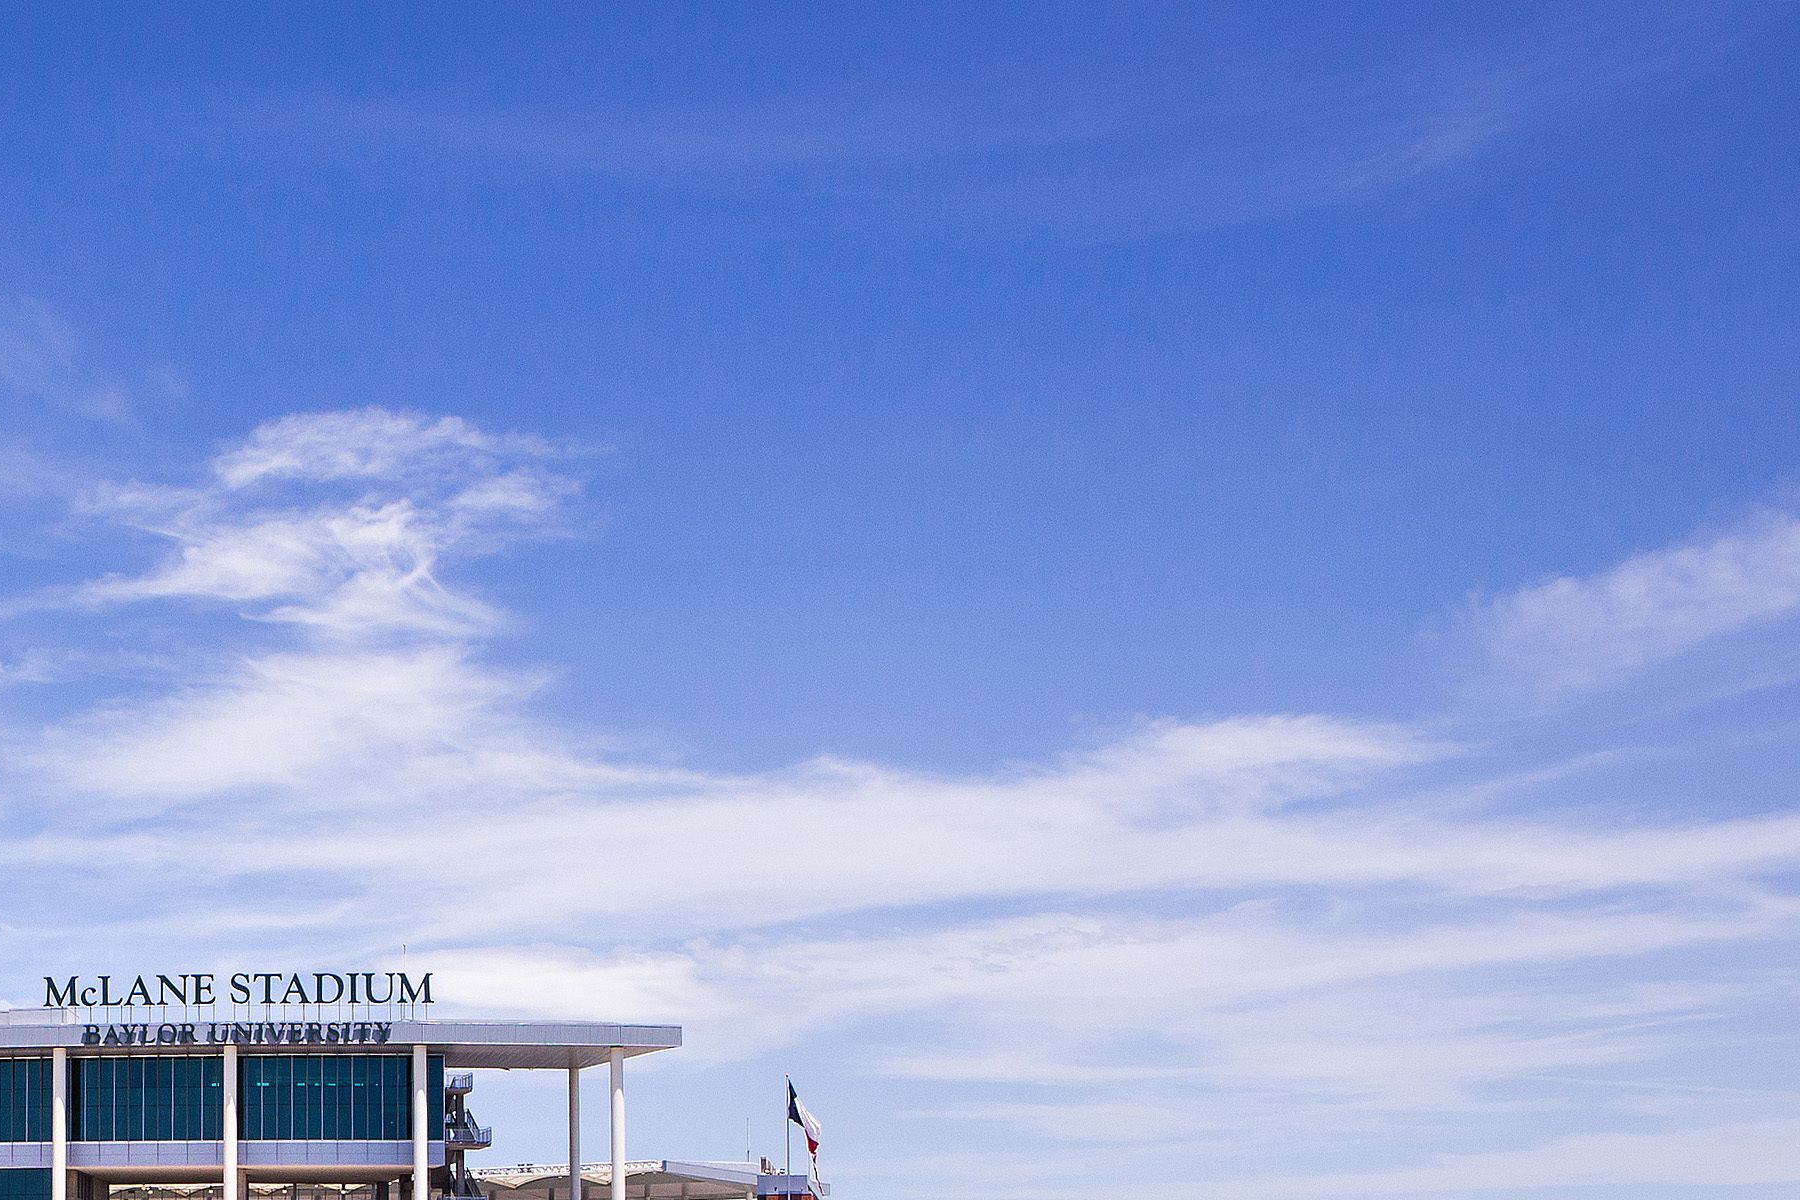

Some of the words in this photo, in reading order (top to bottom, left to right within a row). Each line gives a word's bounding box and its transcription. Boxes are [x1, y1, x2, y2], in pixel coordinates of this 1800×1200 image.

[42, 974, 217, 1007] McLANE
[230, 972, 435, 1005] STADIUM
[82, 1023, 199, 1045] BAYLOR
[208, 1021, 393, 1044] UNIVERSITY
